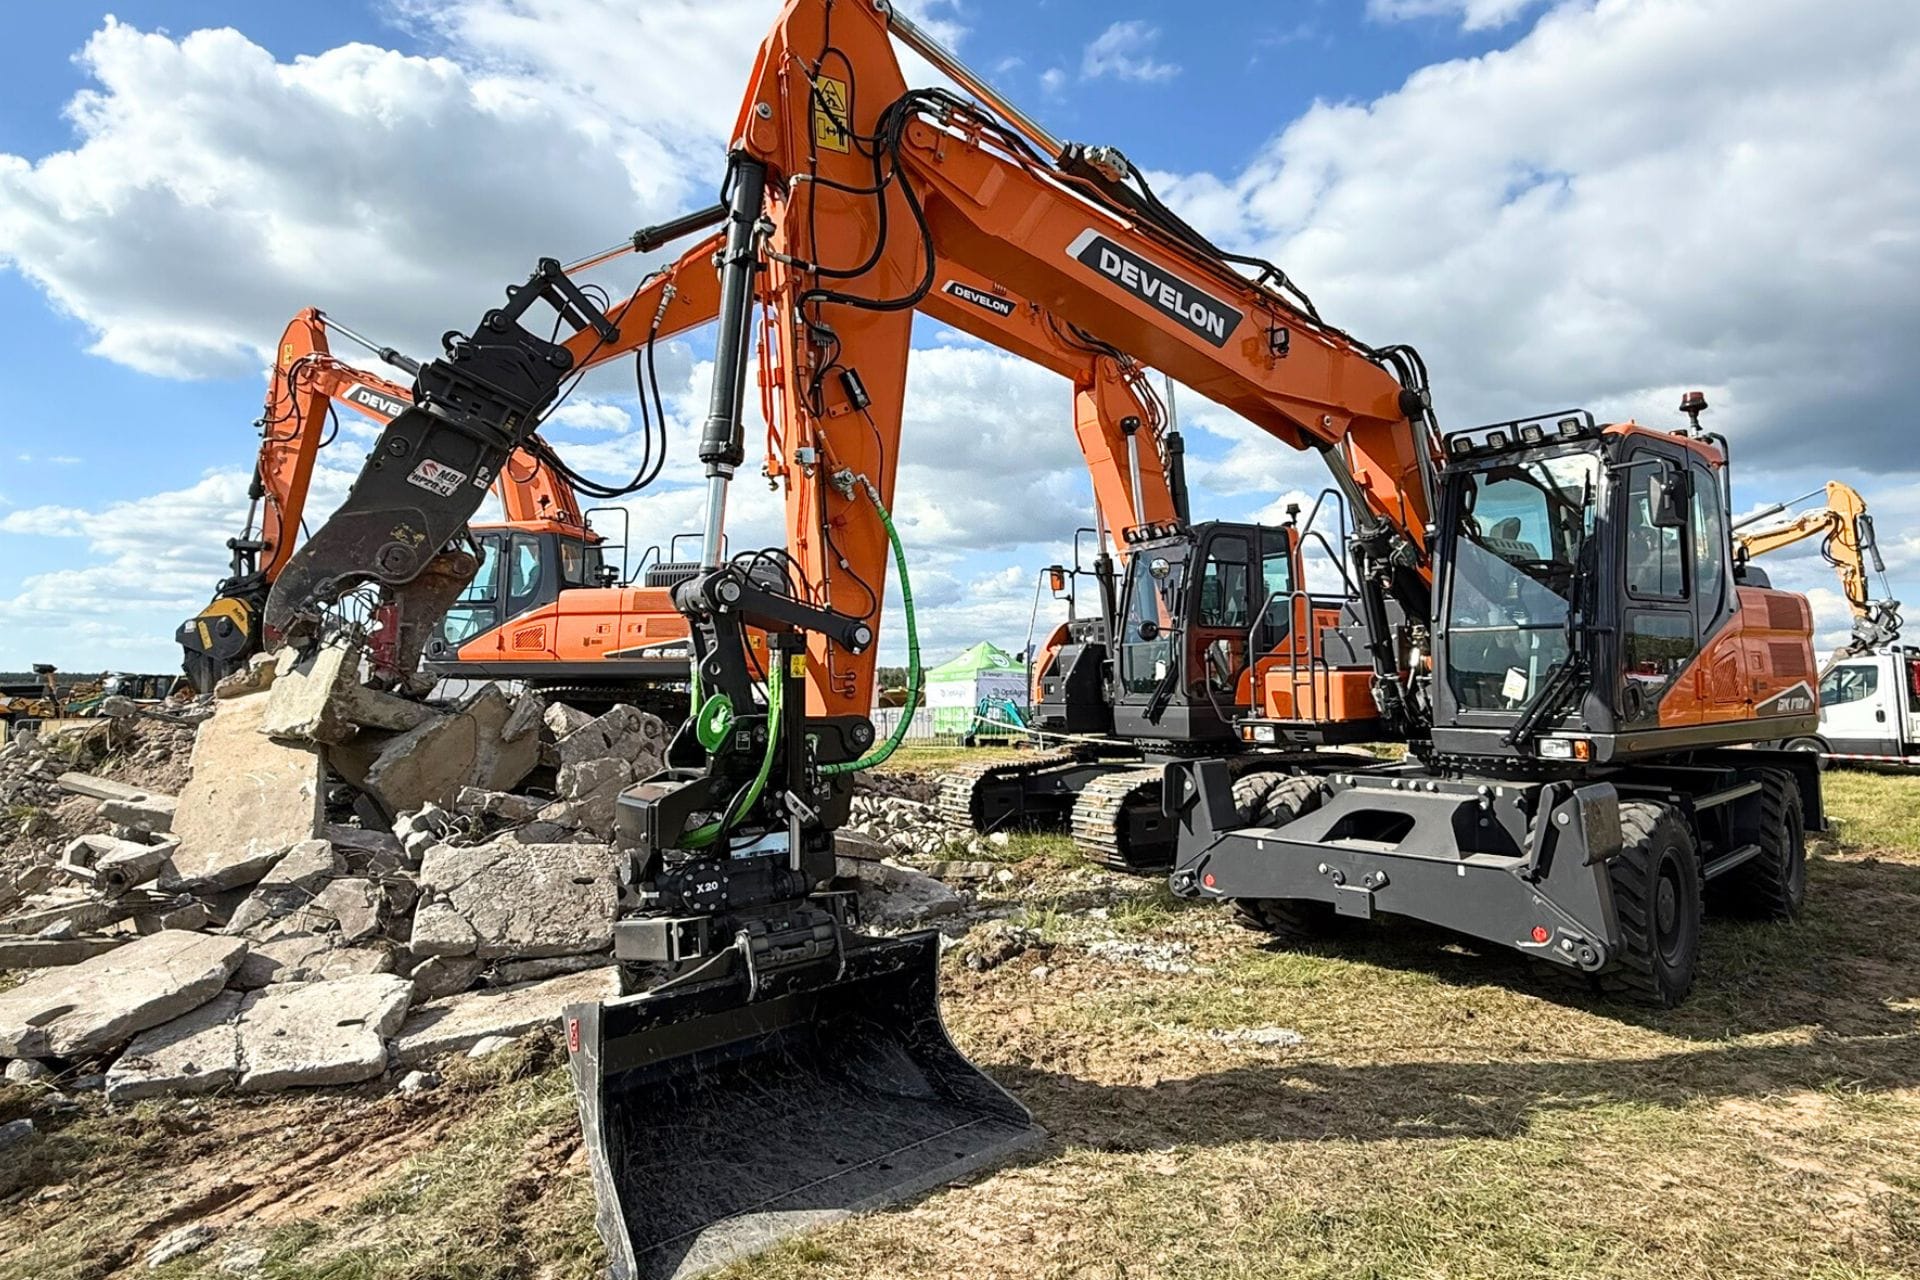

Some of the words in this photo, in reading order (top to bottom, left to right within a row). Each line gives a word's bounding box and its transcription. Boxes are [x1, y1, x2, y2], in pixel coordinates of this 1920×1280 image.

[954, 285, 1009, 314] DEVELON
[1099, 247, 1225, 339] DEVELON
[437, 469, 463, 485] MBI
